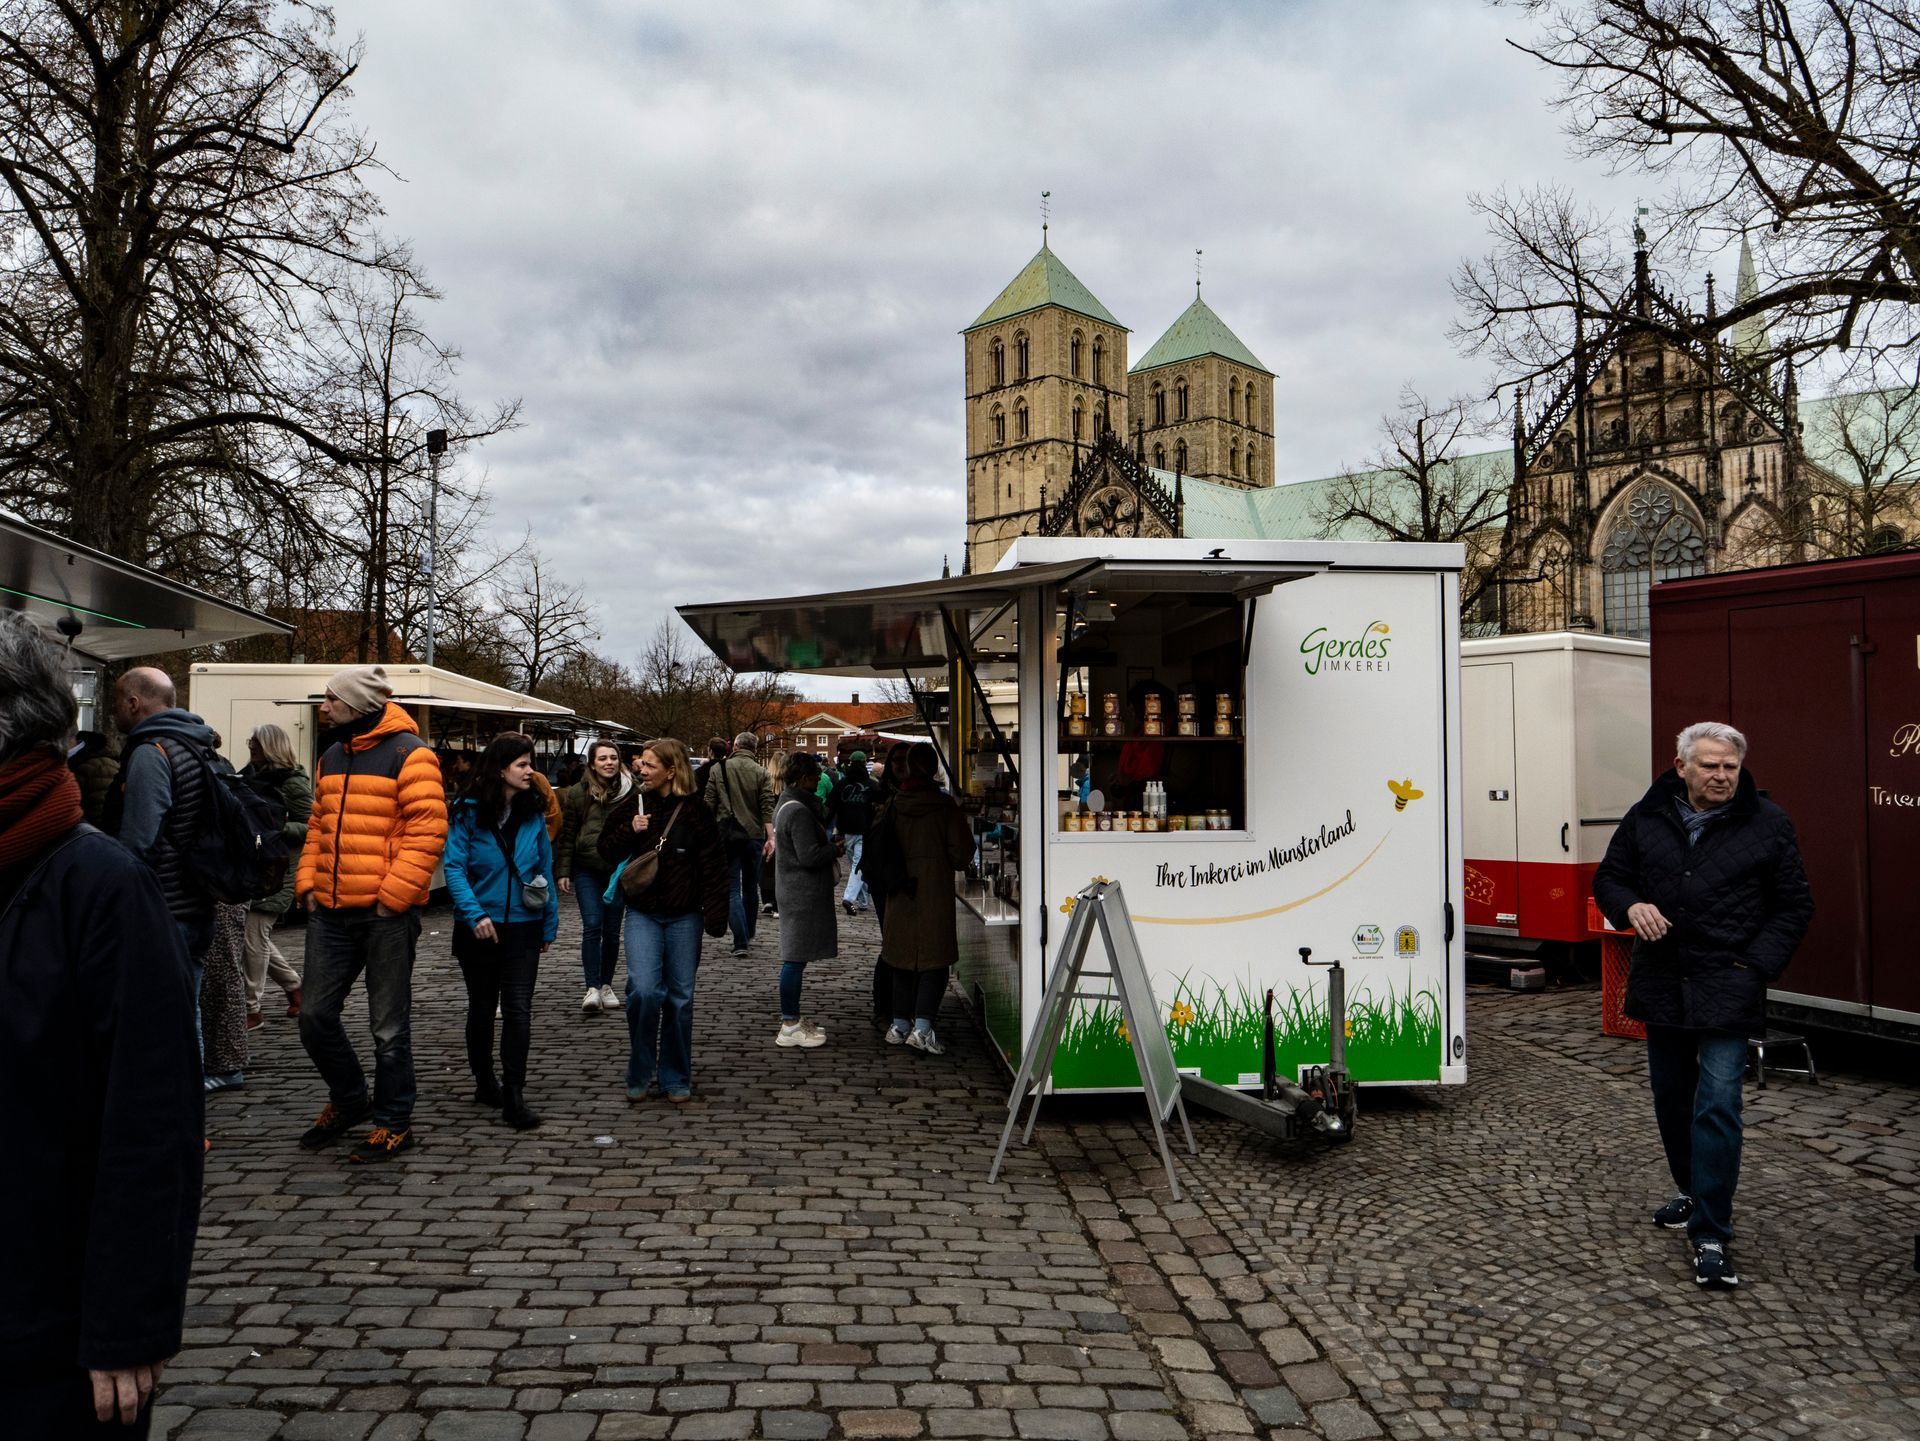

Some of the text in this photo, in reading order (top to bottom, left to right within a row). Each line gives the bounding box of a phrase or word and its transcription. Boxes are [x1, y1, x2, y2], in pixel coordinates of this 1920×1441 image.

[1300, 621, 1391, 675] Gerdes
[1324, 660, 1391, 671] IMKEREI
[1155, 809, 1357, 888] Ihre Imkerei im Münsterland
